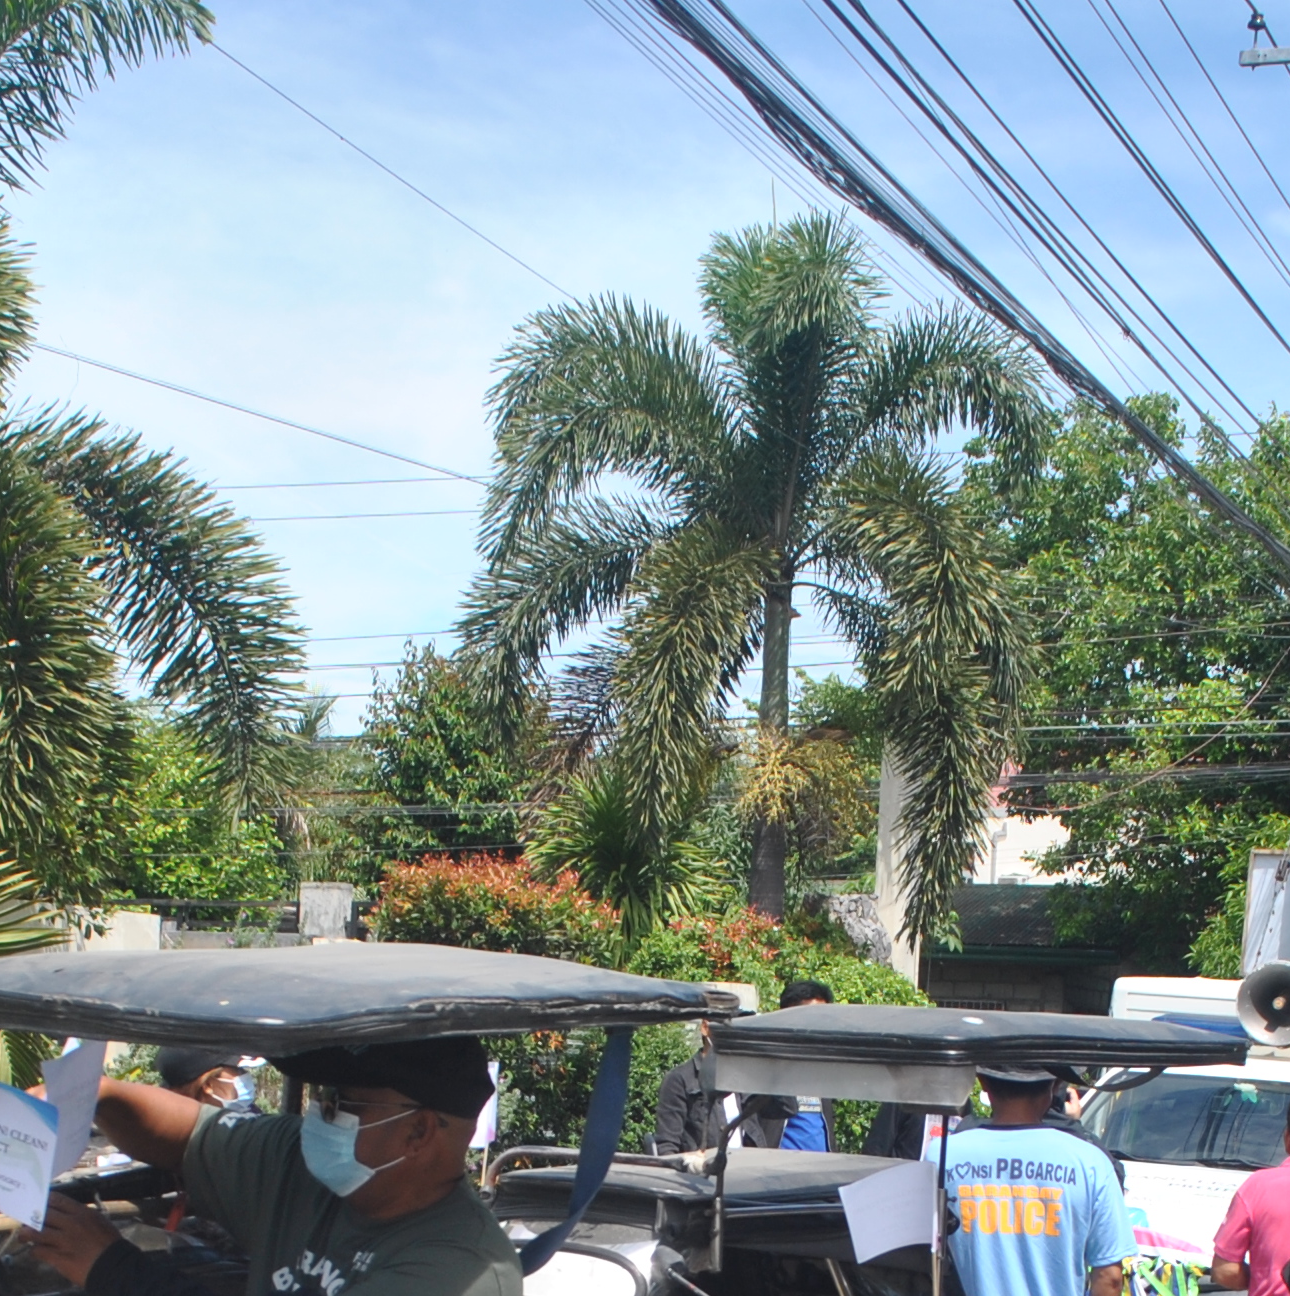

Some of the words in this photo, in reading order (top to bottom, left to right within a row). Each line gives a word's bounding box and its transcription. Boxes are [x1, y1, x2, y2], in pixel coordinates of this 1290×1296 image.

[996, 1158, 1023, 1180] PB
[1025, 1161, 1076, 1186] GARCIA
[958, 1184, 1063, 1201] BARANGAY
[960, 1199, 1062, 1237] POLICE
